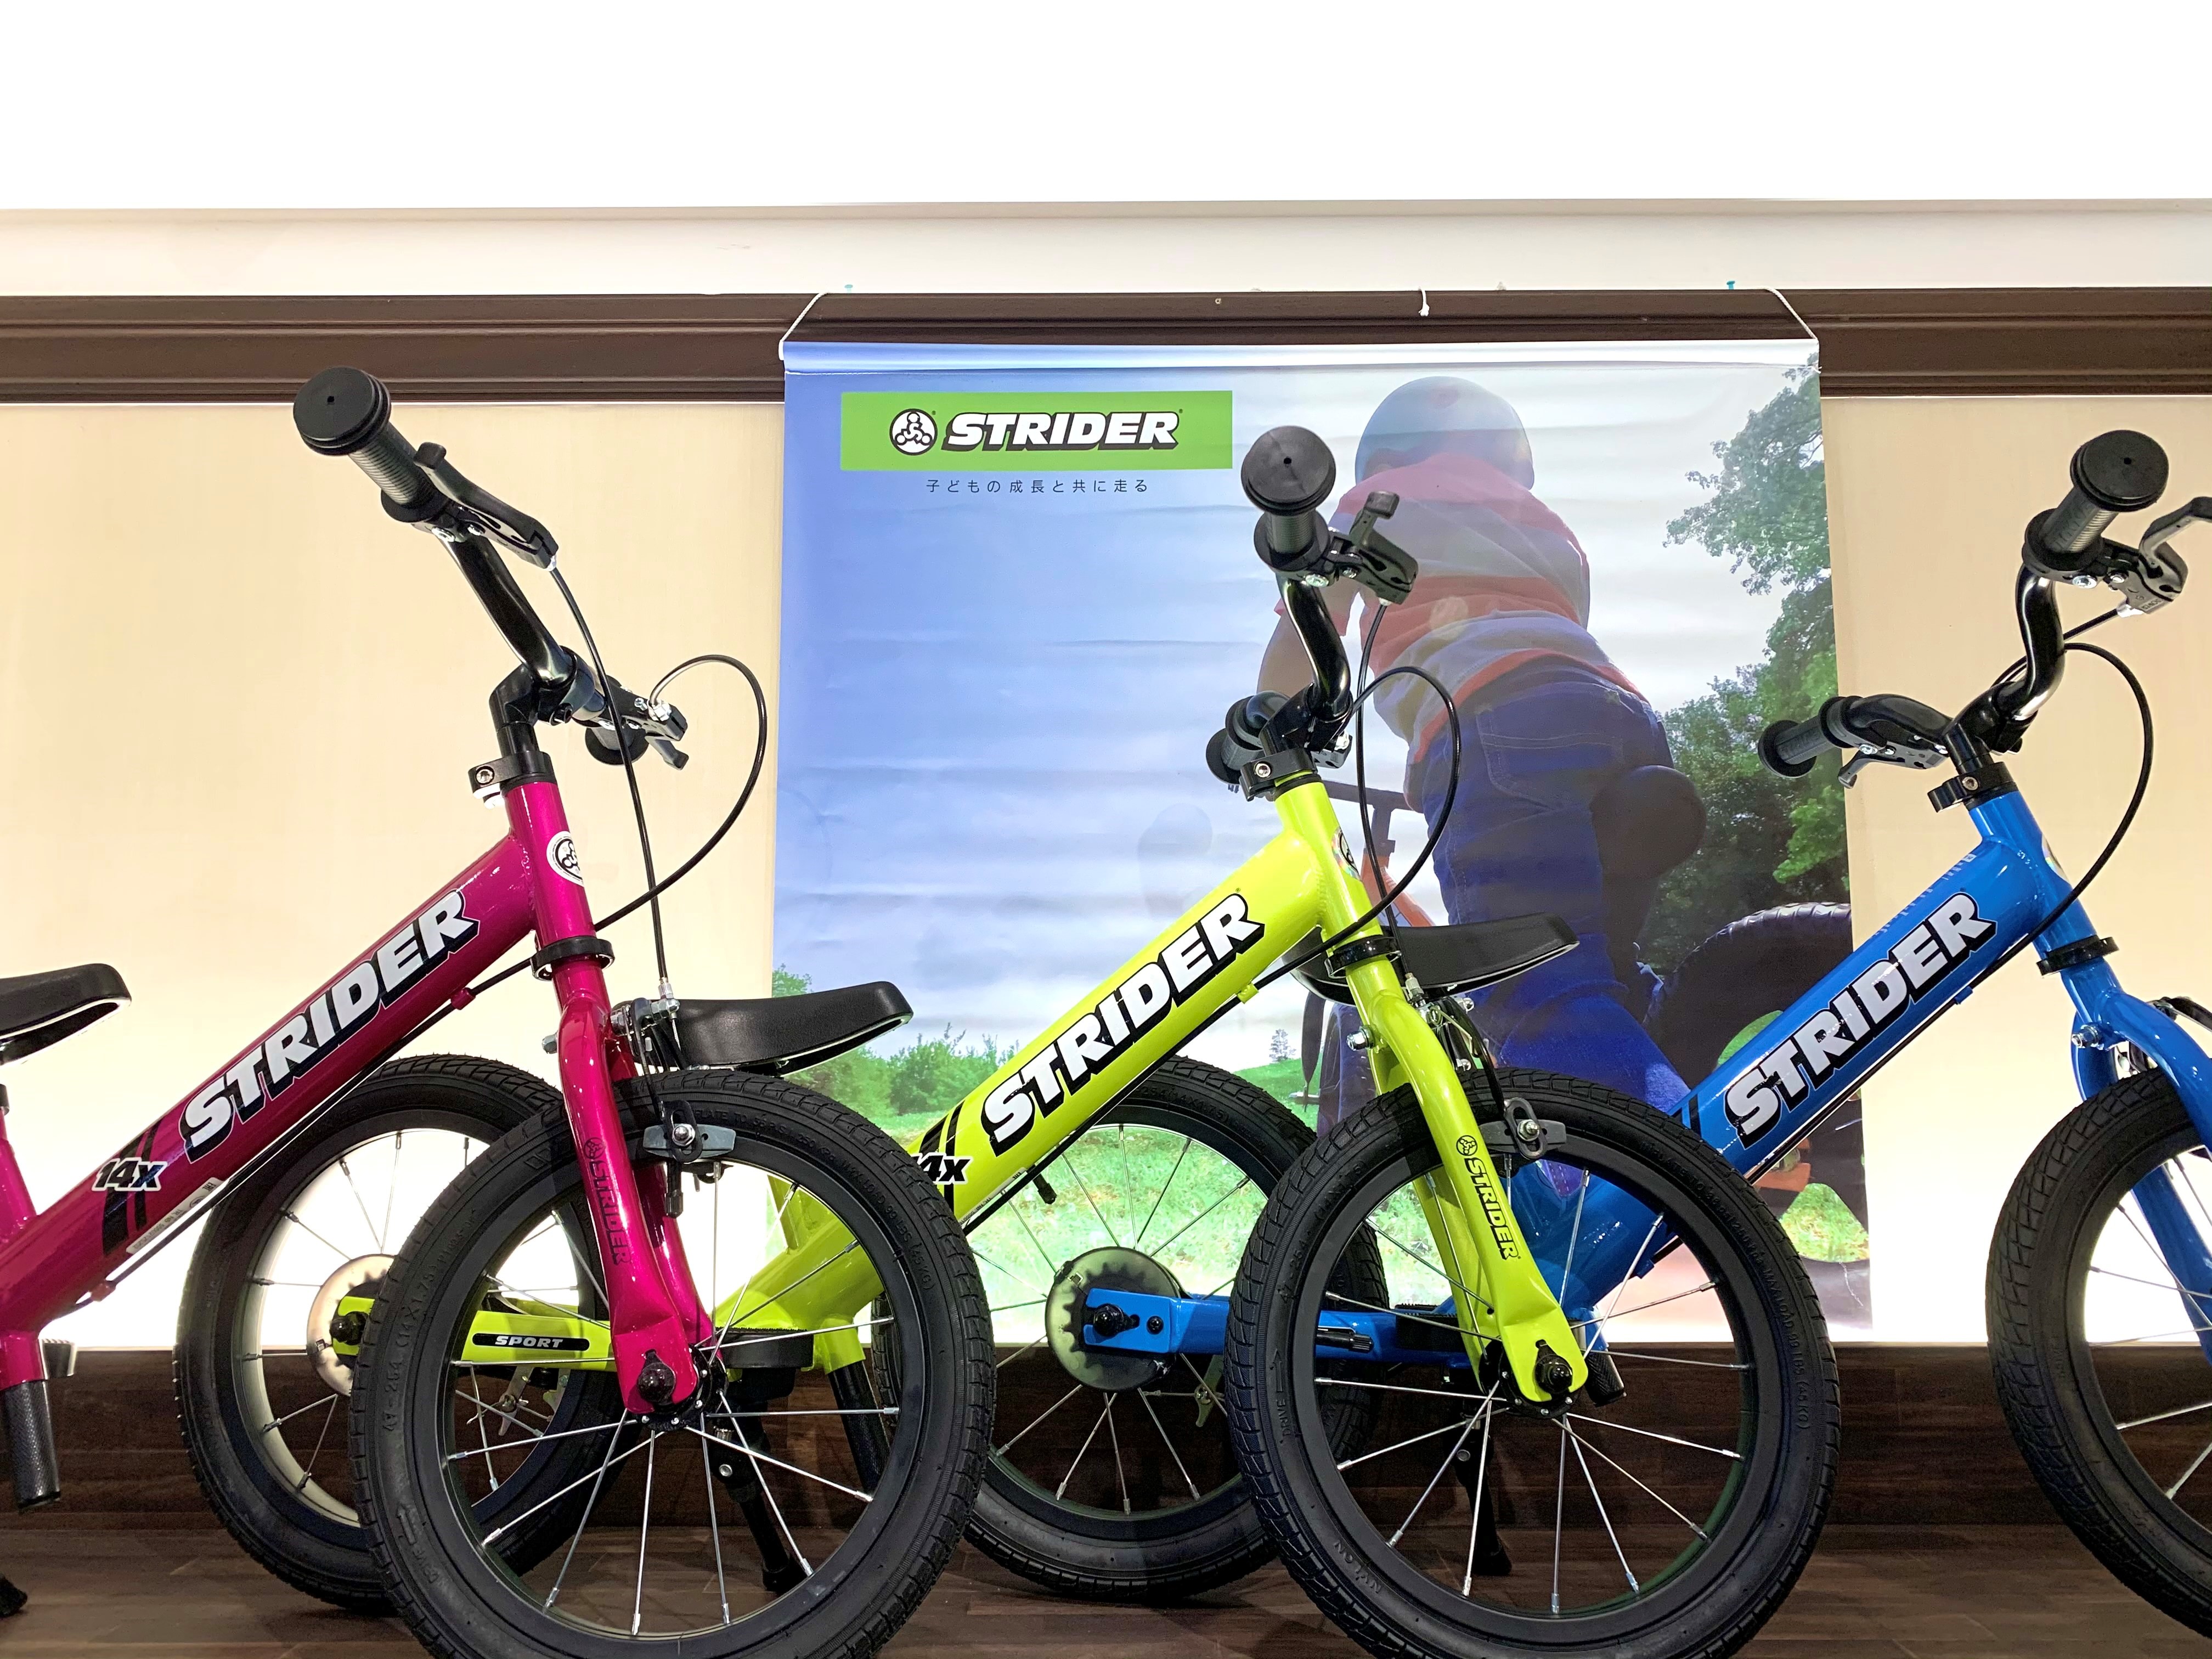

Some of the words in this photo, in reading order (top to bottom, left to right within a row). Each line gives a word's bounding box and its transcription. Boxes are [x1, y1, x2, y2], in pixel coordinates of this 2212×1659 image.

[941, 411, 1179, 451] STRIDER
[926, 479, 1148, 494] 子どもの成長と共に走る
[178, 888, 479, 1164] STRIDER
[981, 894, 1265, 1156] STRIDER
[1725, 893, 1997, 1149] STRIDER
[93, 1158, 167, 1191] 14X
[911, 1153, 972, 1184] 4X
[589, 1160, 632, 1265] STRIDER
[883, 1203, 900, 1220] 99
[894, 1218, 915, 1243] LBS
[1466, 1158, 1519, 1261] STRIDER
[494, 1335, 563, 1348] SPORT
[1332, 1539, 1383, 1594] NYLON
